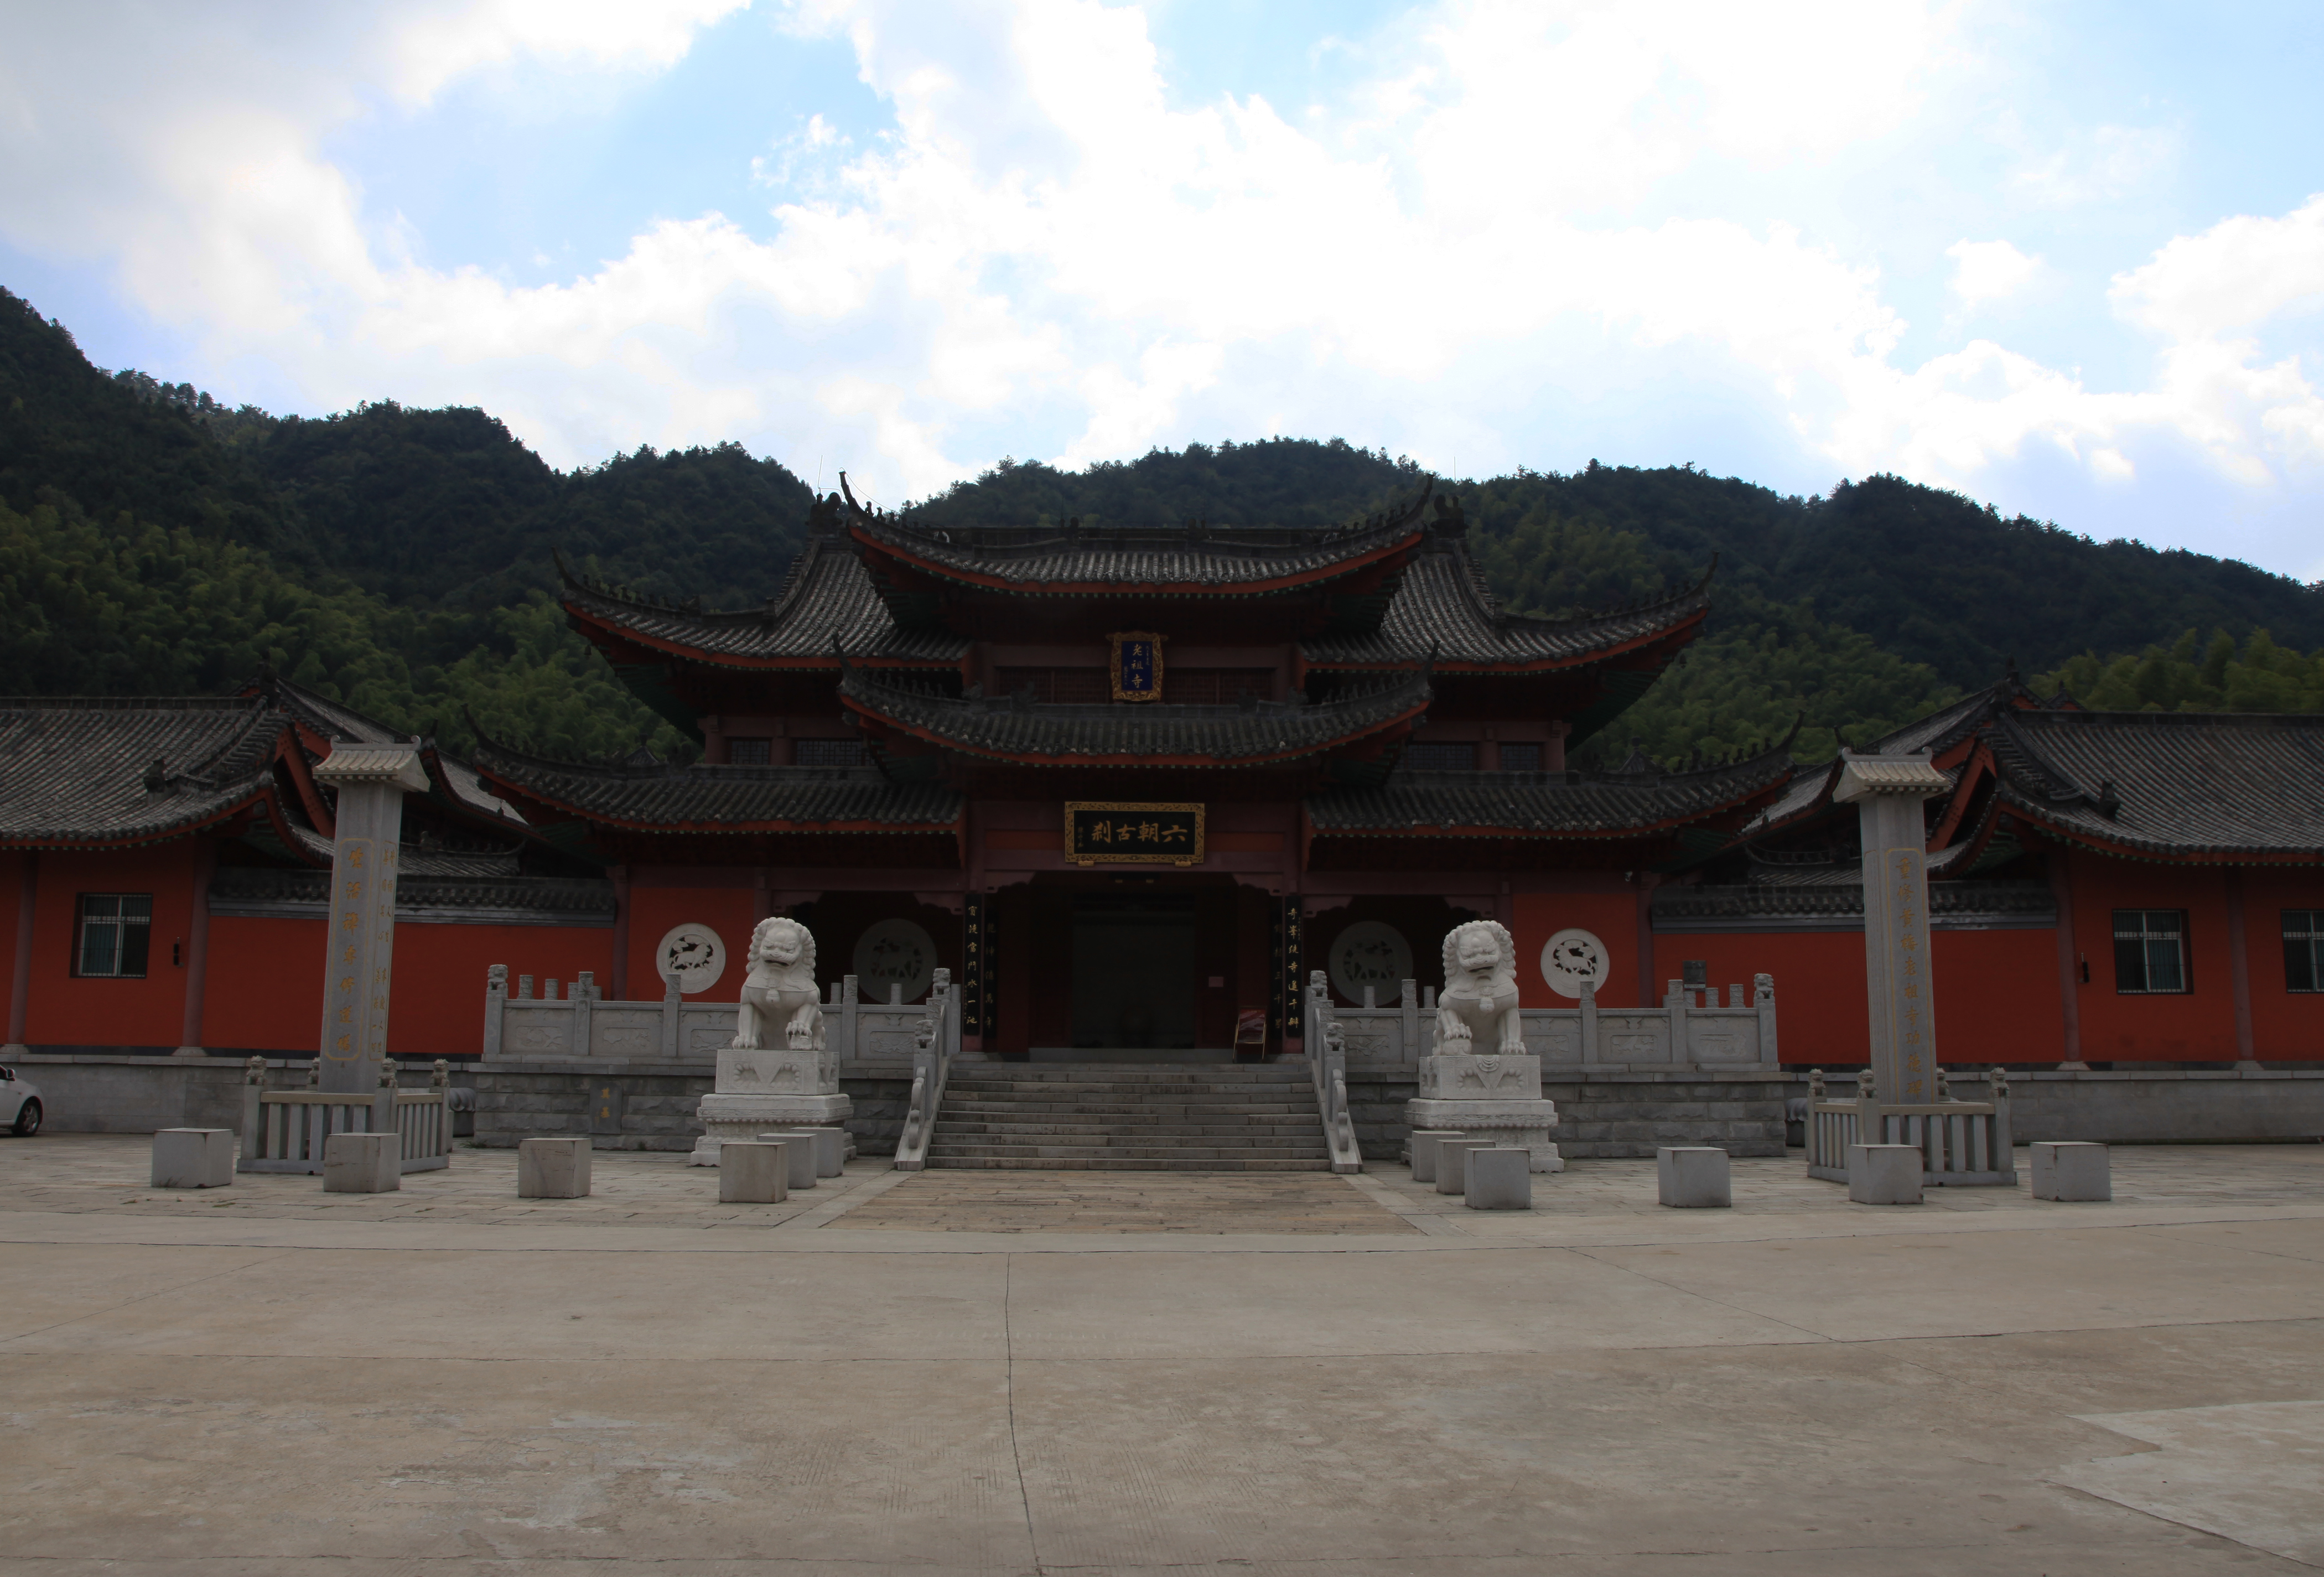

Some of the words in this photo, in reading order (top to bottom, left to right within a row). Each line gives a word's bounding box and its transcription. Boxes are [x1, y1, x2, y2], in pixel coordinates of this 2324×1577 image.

[1131, 644, 1143, 688] 老祖寺
[1091, 821, 1188, 843] 六朝古刹
